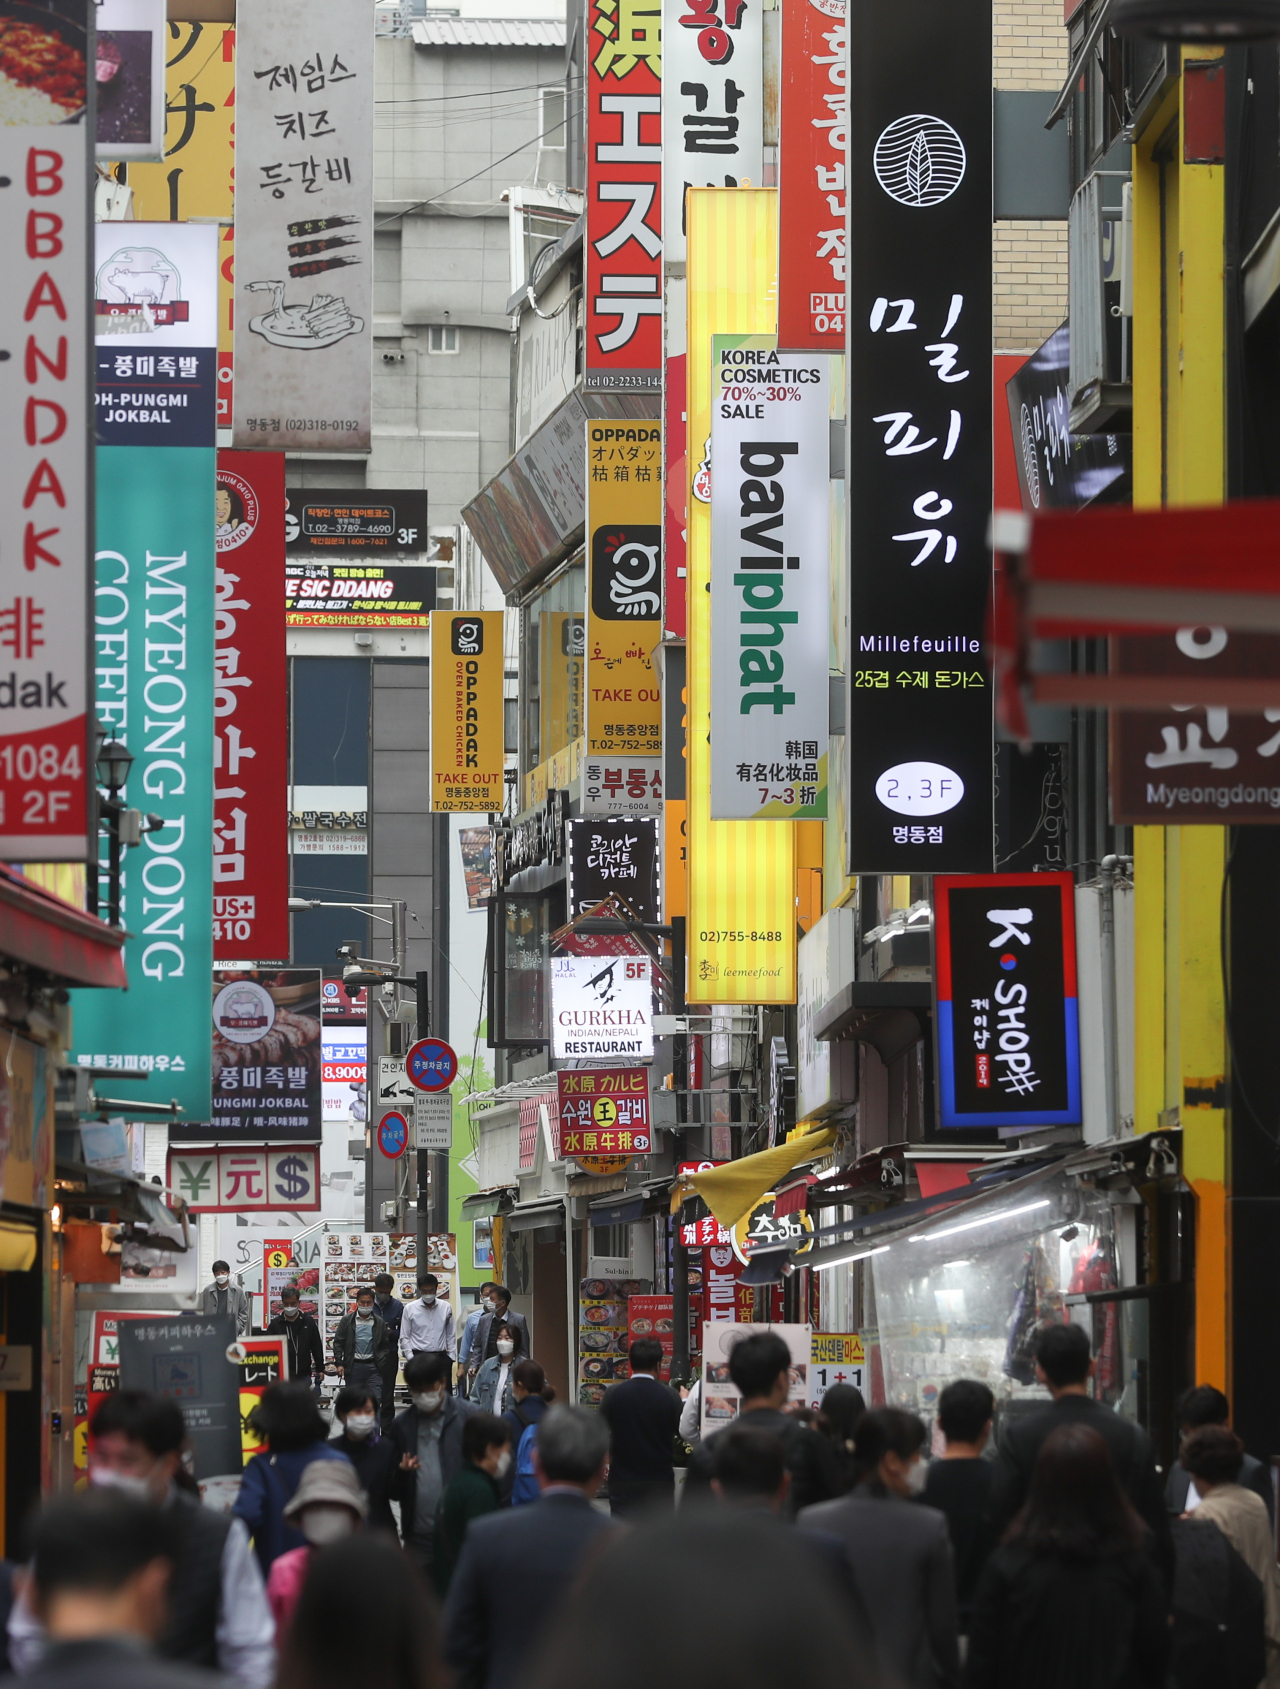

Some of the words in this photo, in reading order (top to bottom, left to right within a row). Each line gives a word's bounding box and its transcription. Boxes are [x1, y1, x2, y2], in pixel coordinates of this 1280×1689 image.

[254, 52, 356, 93] 제임스
[274, 110, 336, 140] 치즈
[677, 0, 746, 236] 왕갈
[260, 155, 352, 198] 등갈비
[24, 146, 67, 571] BBANDAK
[722, 350, 780, 364] KOREA
[588, 376, 600, 386] tel
[720, 369, 820, 384] COSMETICS
[105, 410, 170, 423] JOKBAL
[720, 404, 764, 418] SALE
[246, 418, 280, 432] 명동점
[286, 418, 359, 432] (02)318-0192
[869, 294, 969, 567] 밀피유
[592, 446, 661, 462] オパダッ
[397, 528, 418, 544] 3F
[734, 442, 800, 714] baviphat
[286, 580, 300, 596] E
[300, 580, 330, 598] SIC
[331, 581, 394, 598] DDANG
[859, 636, 980, 654] Millefeuille
[143, 550, 187, 800] MYEONG
[855, 671, 890, 689] 25겹
[896, 671, 929, 689] 수제
[934, 671, 984, 689] 돈가스
[592, 689, 632, 701] TAKE
[465, 660, 478, 768] OPPADAK
[604, 724, 659, 736] 명동중앙점
[785, 740, 818, 760] 韩国
[436, 773, 468, 784] TAKE
[472, 773, 499, 784] OUT
[736, 762, 818, 782] 有名化妆品
[445, 787, 489, 798] 명동중앙점
[22, 790, 71, 823] 2F
[434, 801, 500, 810] T.02-752-5892
[892, 825, 943, 844] 명동점
[590, 833, 638, 853] 코리안
[587, 851, 632, 868] 디저트
[600, 864, 637, 880] 카페
[142, 814, 186, 982] DONG
[986, 908, 1033, 948] K
[700, 931, 782, 943] 02)755-8488
[626, 962, 646, 979] 5F
[723, 967, 783, 980] leemeefood
[559, 1009, 647, 1026] GURKHA
[567, 1028, 639, 1038] INDIAN/NEPALI
[565, 1041, 642, 1053] RESTAURANT
[414, 1060, 450, 1070] 주정차금지
[563, 1075, 595, 1093] 水原
[600, 1074, 644, 1092] カルビ
[259, 1098, 308, 1108] JOKBAL
[636, 1137, 648, 1147] 3F
[225, 1159, 263, 1200] 元
[275, 1155, 310, 1201] $
[273, 1253, 282, 1268] $
[239, 1355, 279, 1365] xchange
[245, 1366, 277, 1382] レート
[92, 1376, 116, 1392] 高い
